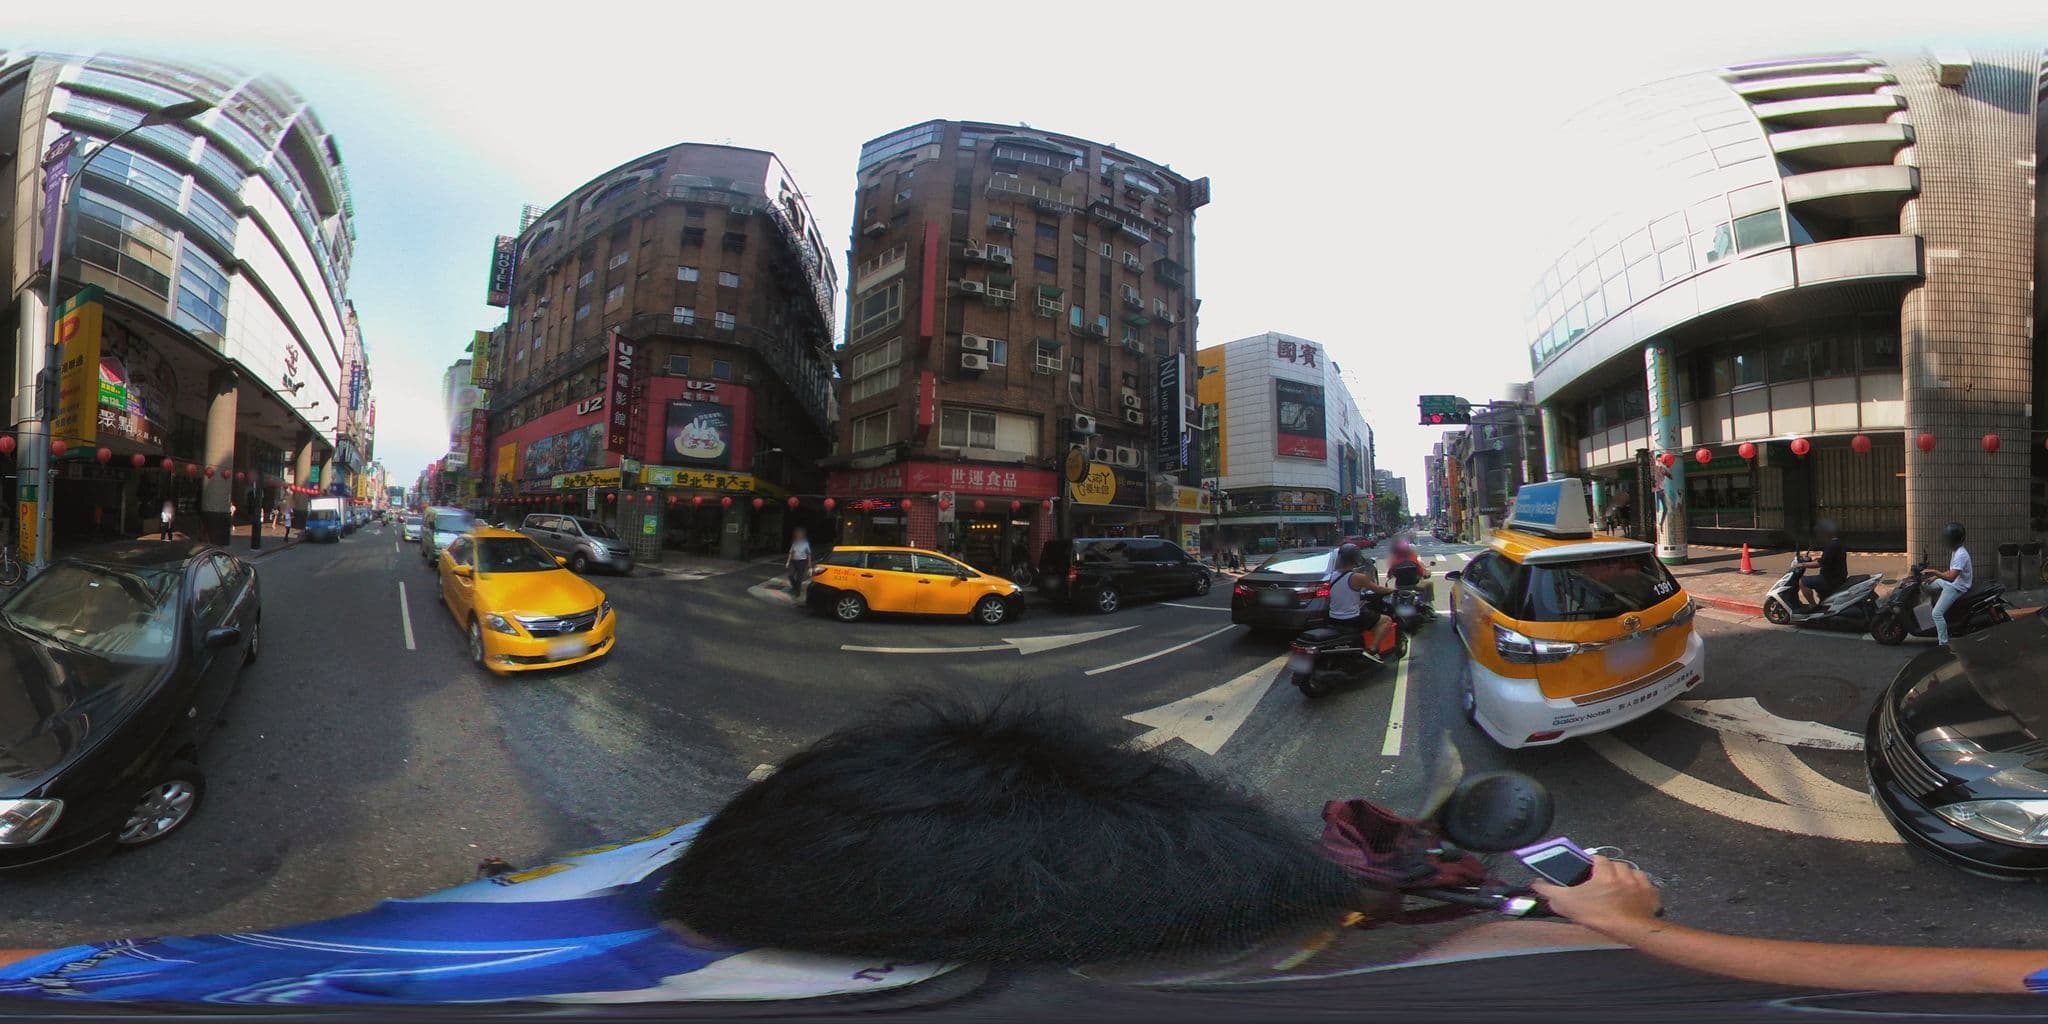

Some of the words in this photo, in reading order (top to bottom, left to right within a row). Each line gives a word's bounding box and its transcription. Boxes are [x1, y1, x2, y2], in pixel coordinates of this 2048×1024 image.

[496, 251, 510, 292] HOTEL
[61, 317, 80, 342] P
[618, 342, 633, 369] U2
[1277, 339, 1317, 368] 國賓
[1160, 359, 1176, 388] NU
[687, 380, 717, 391] U2
[577, 397, 603, 415] U2
[614, 373, 629, 426] 電影館
[612, 434, 625, 445] 2F
[676, 472, 751, 489] 台北牛乳大王
[951, 468, 1017, 488] 世運食品
[1653, 579, 1673, 597] 1391
[1552, 714, 1585, 726] Galaxy
[1586, 708, 1611, 720] Note8
